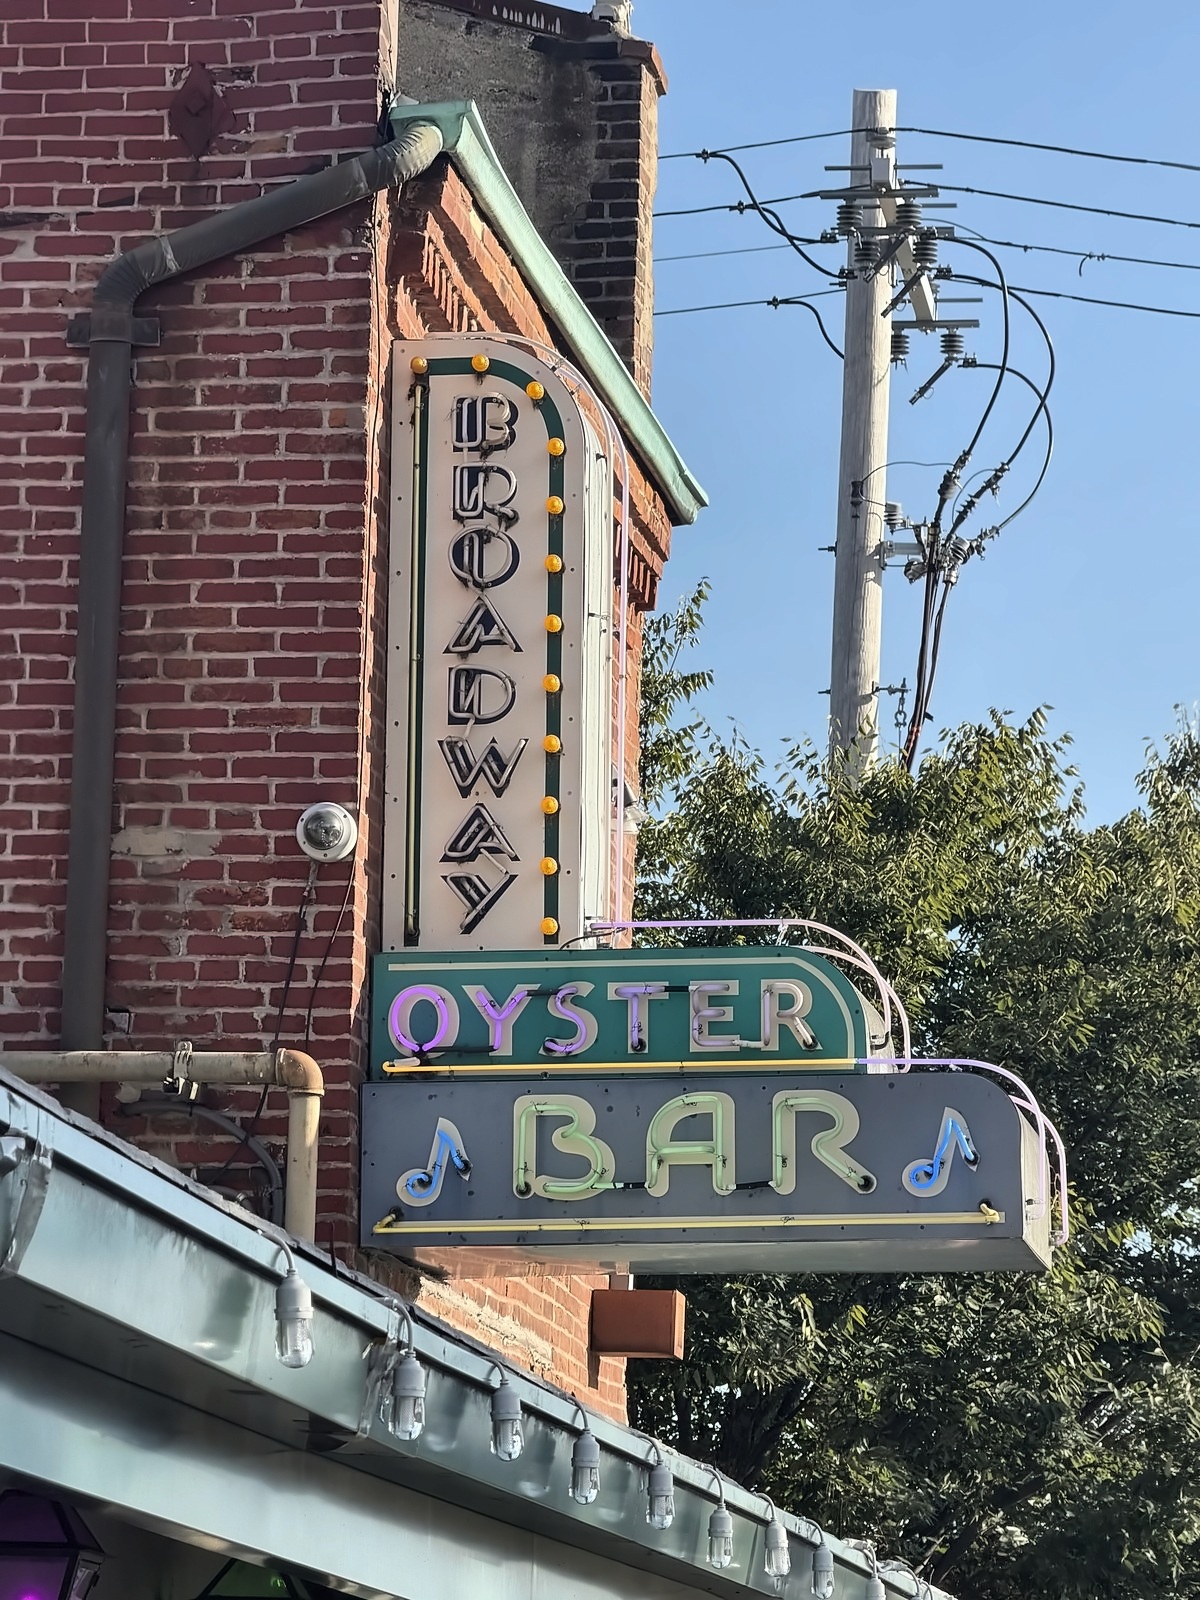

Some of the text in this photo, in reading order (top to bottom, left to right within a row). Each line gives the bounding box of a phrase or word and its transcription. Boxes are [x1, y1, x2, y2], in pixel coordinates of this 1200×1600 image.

[437, 392, 528, 934] BROADWAY
[388, 979, 822, 1056] OYSTER
[513, 1089, 878, 1200] BAR
